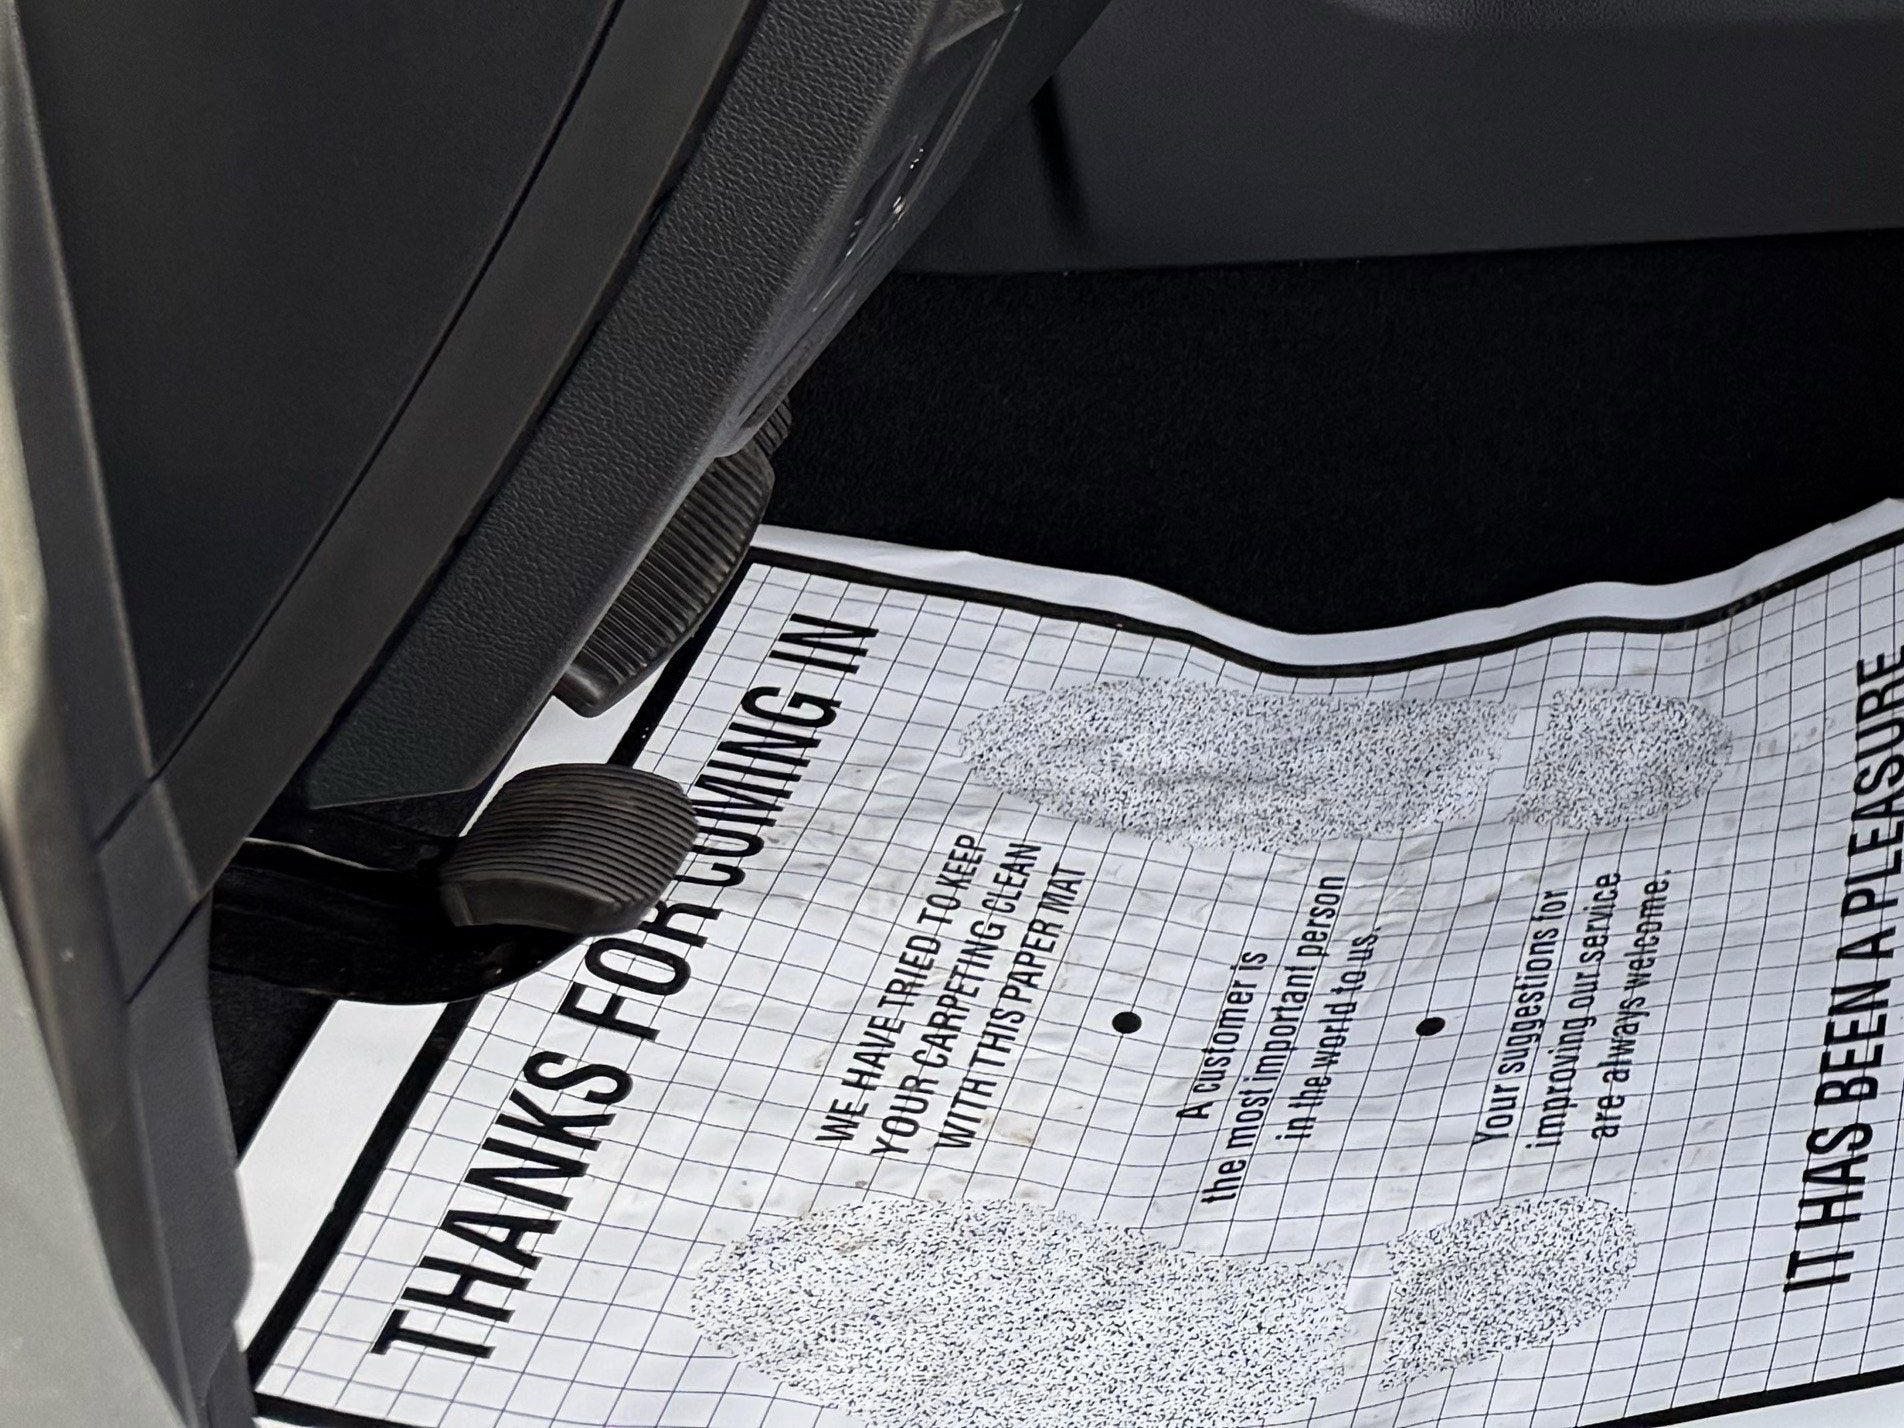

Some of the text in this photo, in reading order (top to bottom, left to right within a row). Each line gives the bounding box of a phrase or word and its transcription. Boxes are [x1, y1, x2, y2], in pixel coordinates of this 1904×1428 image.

[371, 1051, 633, 1359] THANKS
[558, 899, 723, 1040] FOR
[769, 612, 879, 674] IN
[815, 834, 987, 1142] WE HAVE TRIED TO KEEP
[870, 843, 1042, 1155] YOUR CARPETING CLEAN
[934, 862, 1086, 1149] WITH THIS PAPER MAT
[1176, 951, 1268, 1120] A customer is
[1201, 875, 1347, 1205] the most important person
[1275, 927, 1382, 1141] in the world to us.
[1472, 889, 1568, 1147] Your suggestions for
[1525, 872, 1621, 1149] improving our service
[1591, 868, 1672, 1141] are always welcome.
[1815, 977, 1892, 1107] BEEN
[1836, 925, 1896, 960] A
[1783, 1250, 1855, 1294] IT
[1795, 1122, 1875, 1231] HAS
